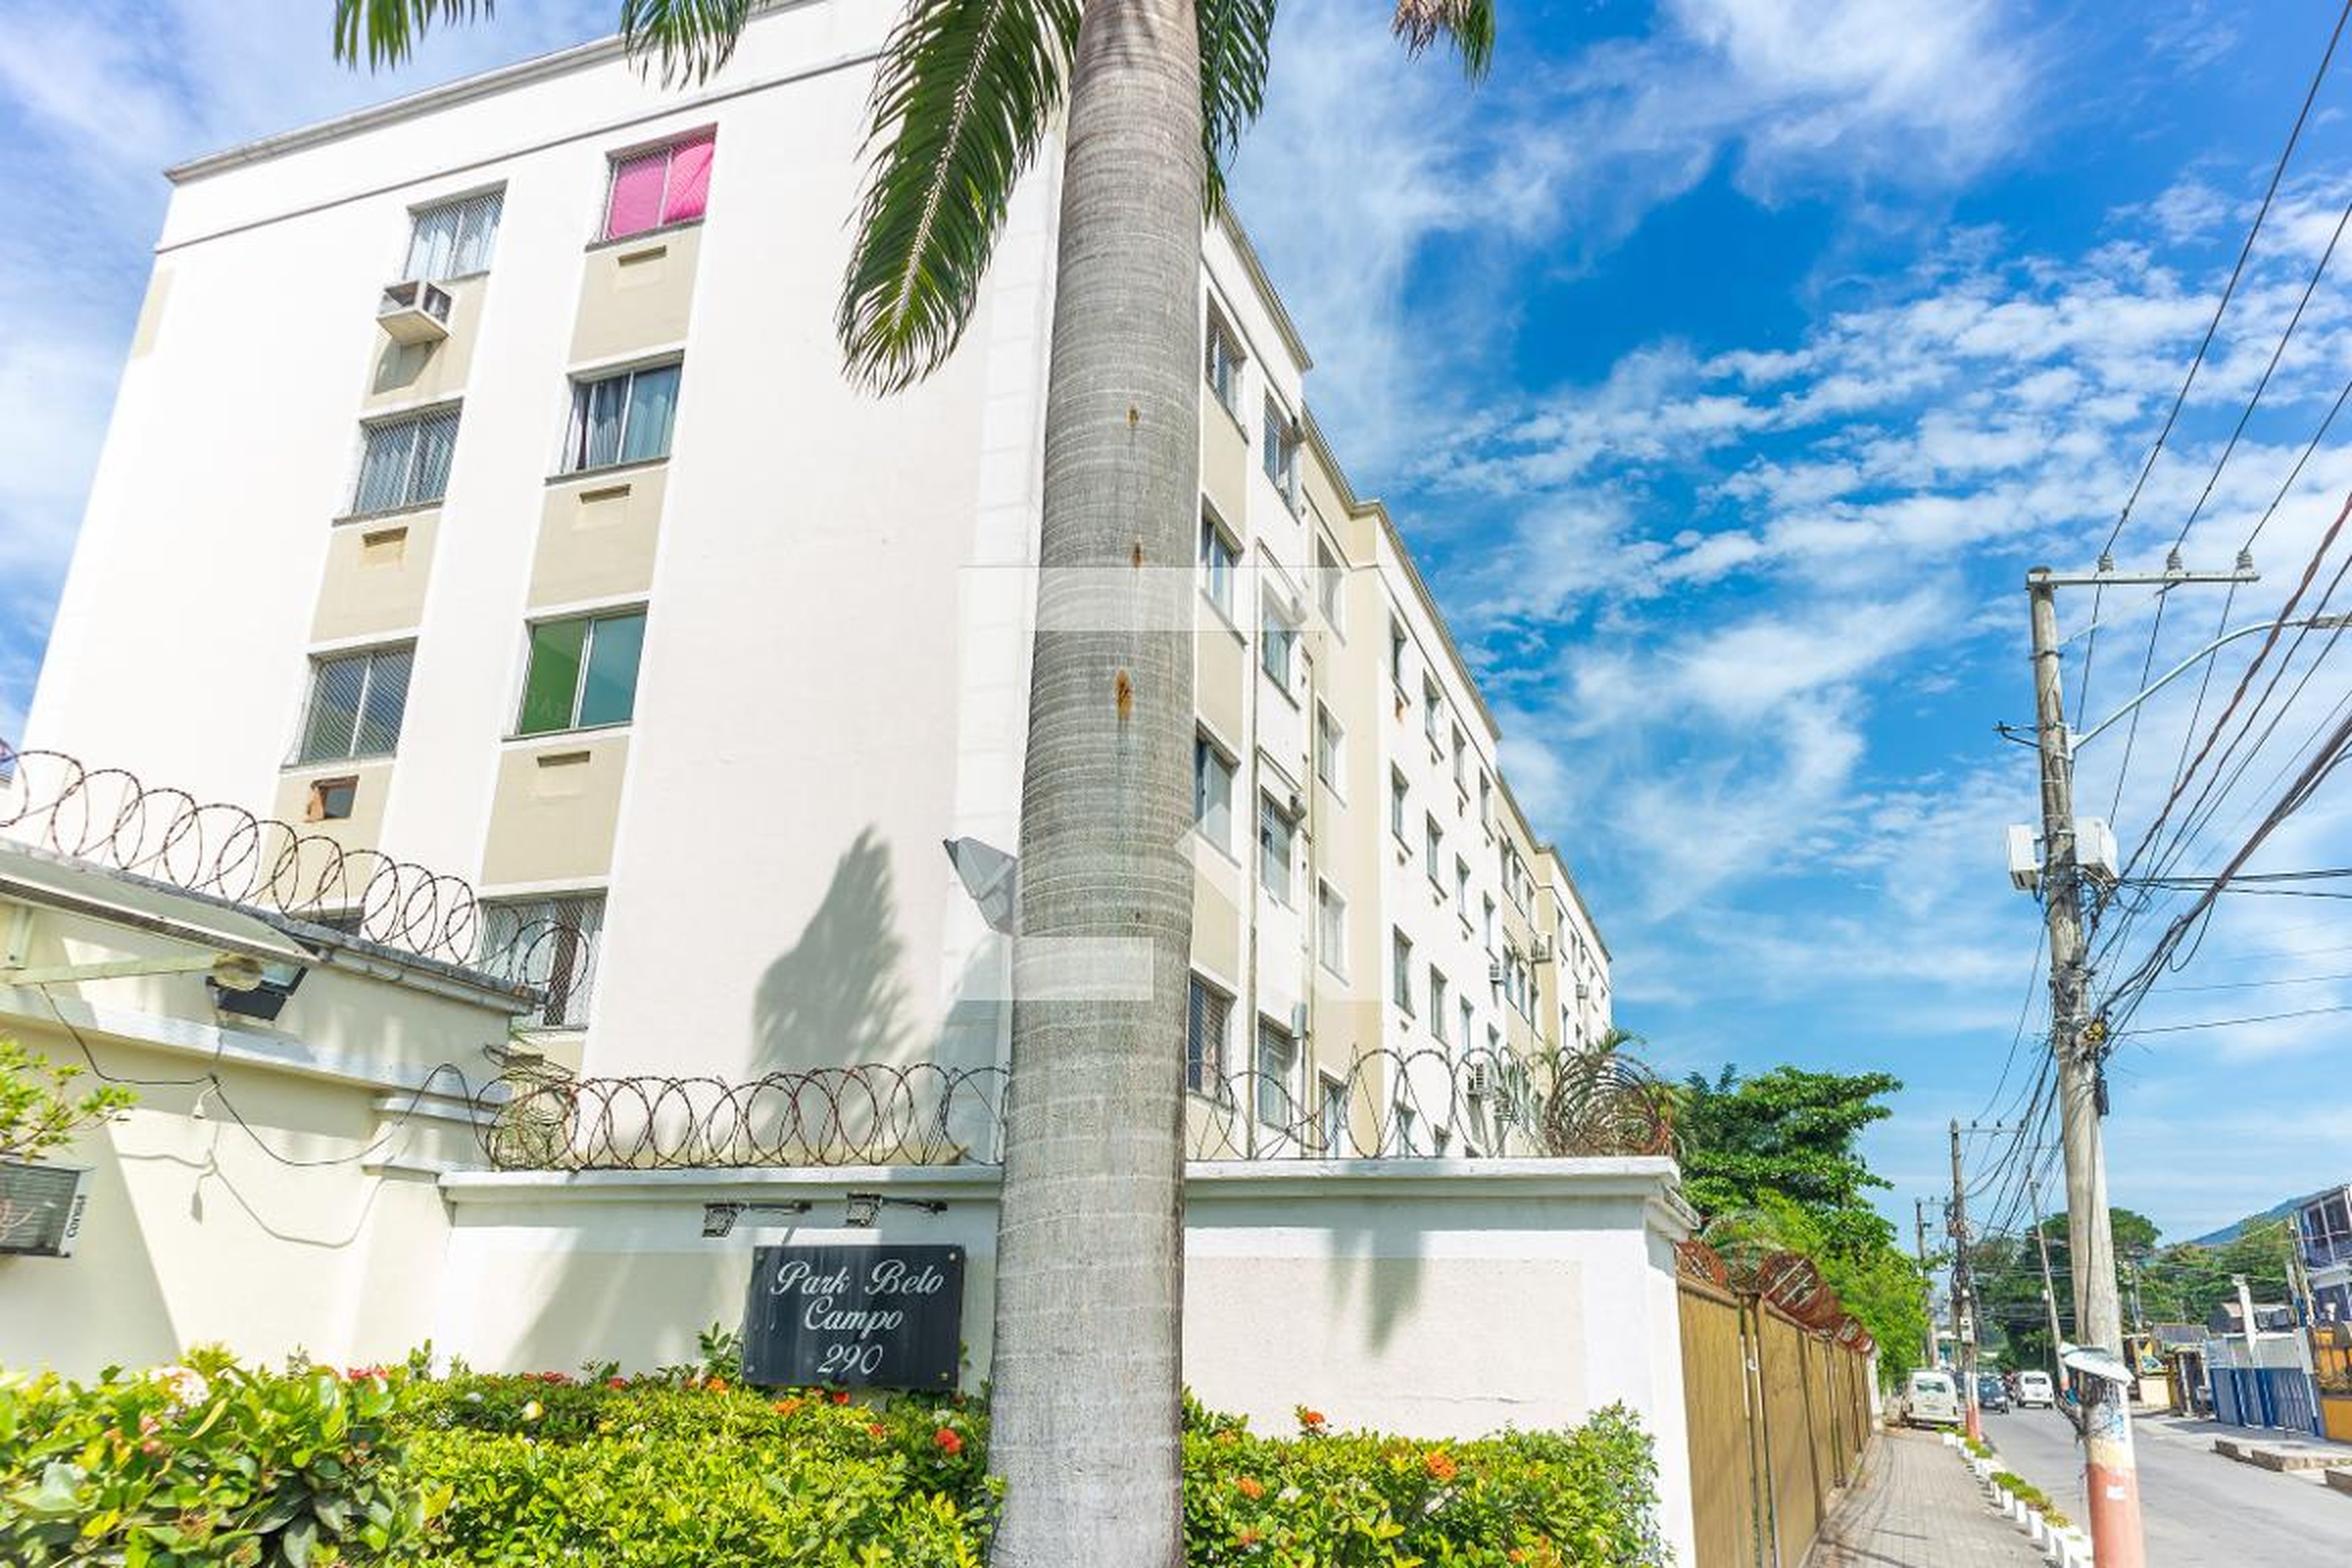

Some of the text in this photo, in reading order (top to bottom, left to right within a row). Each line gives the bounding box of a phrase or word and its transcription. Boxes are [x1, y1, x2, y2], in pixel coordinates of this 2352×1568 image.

[771, 1259, 945, 1295] Park Belo
[804, 1295, 903, 1340] Campo
[816, 1343, 883, 1375] 290
